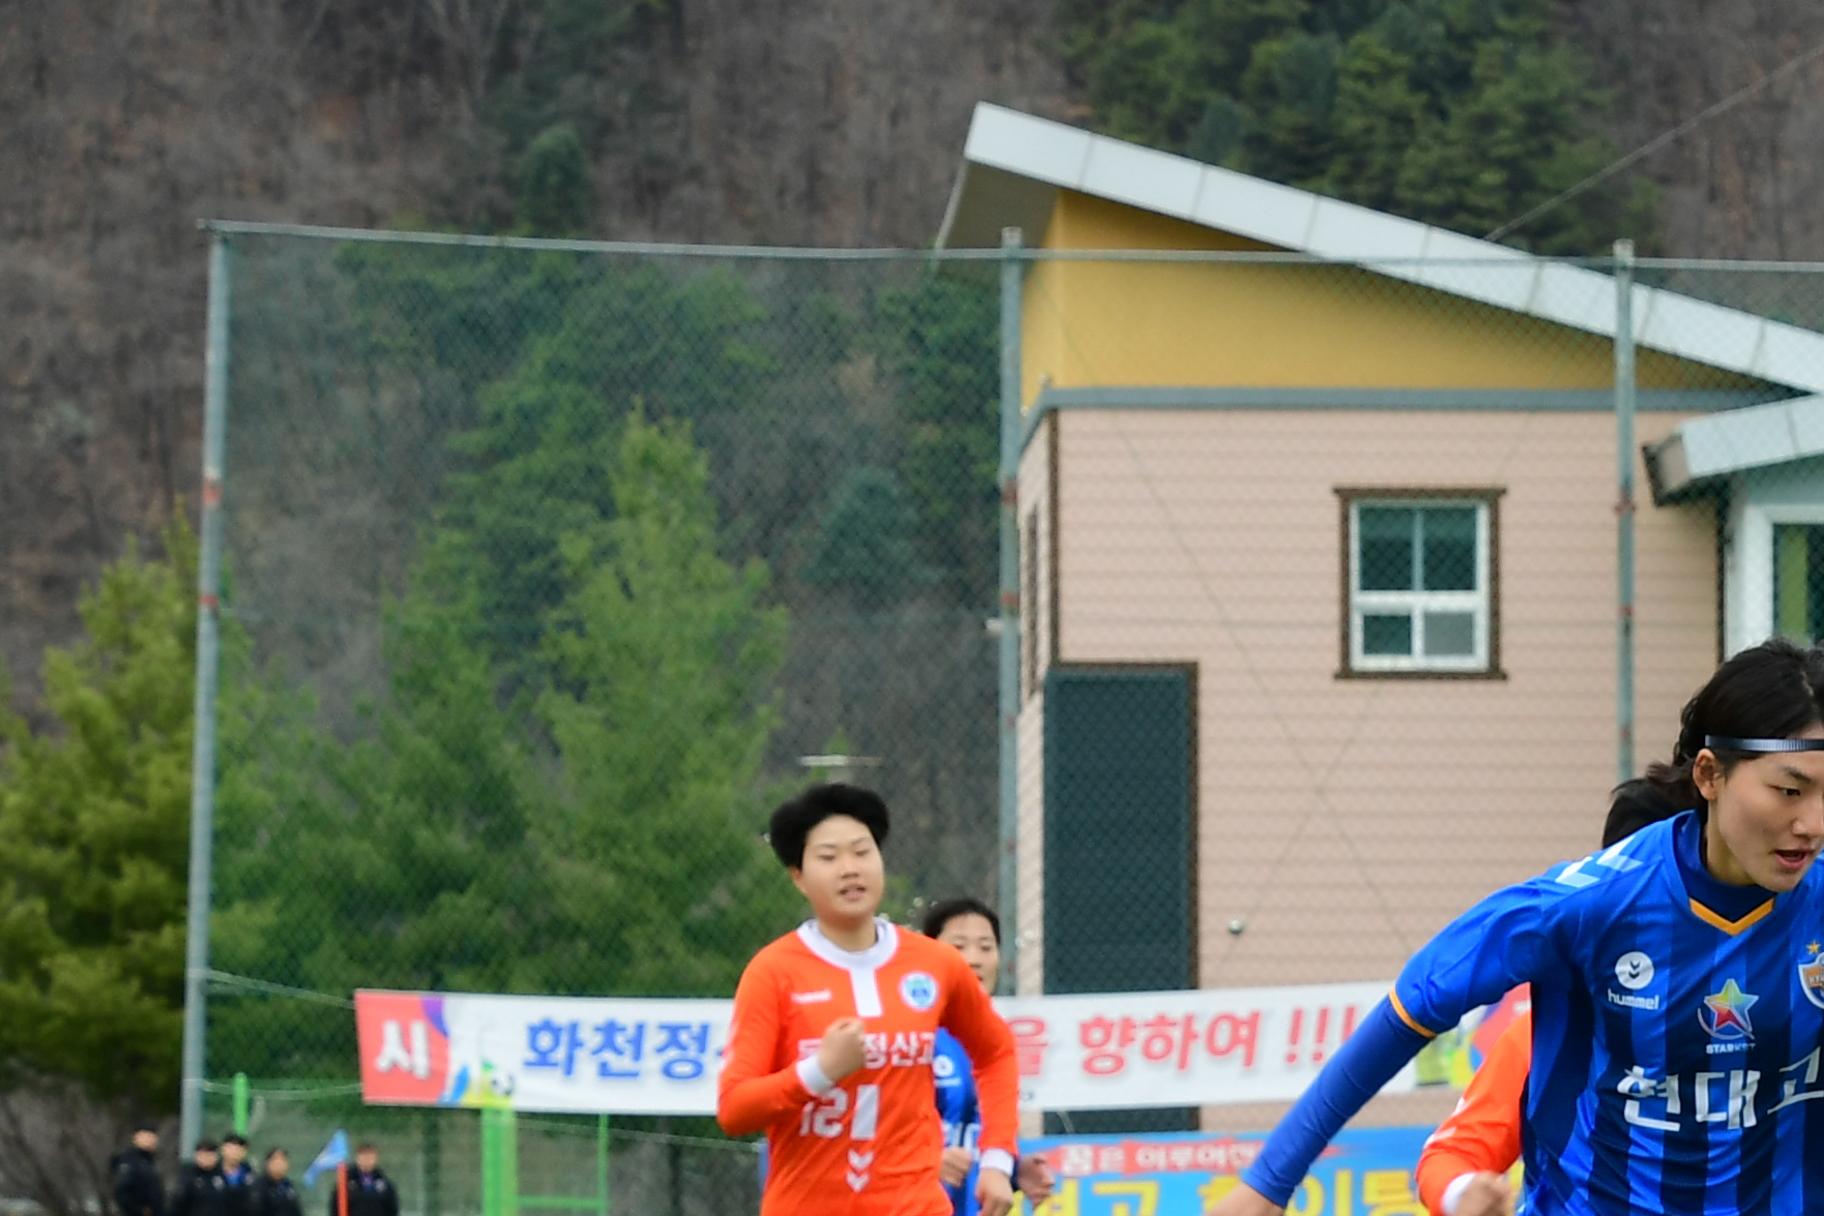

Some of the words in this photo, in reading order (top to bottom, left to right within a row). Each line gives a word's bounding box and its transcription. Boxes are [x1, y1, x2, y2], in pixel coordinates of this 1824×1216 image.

[1607, 988, 1660, 1011] hummel
[376, 1019, 430, 1080] 시
[523, 1017, 727, 1080] 화천정
[1079, 1009, 1262, 1077] 향하여
